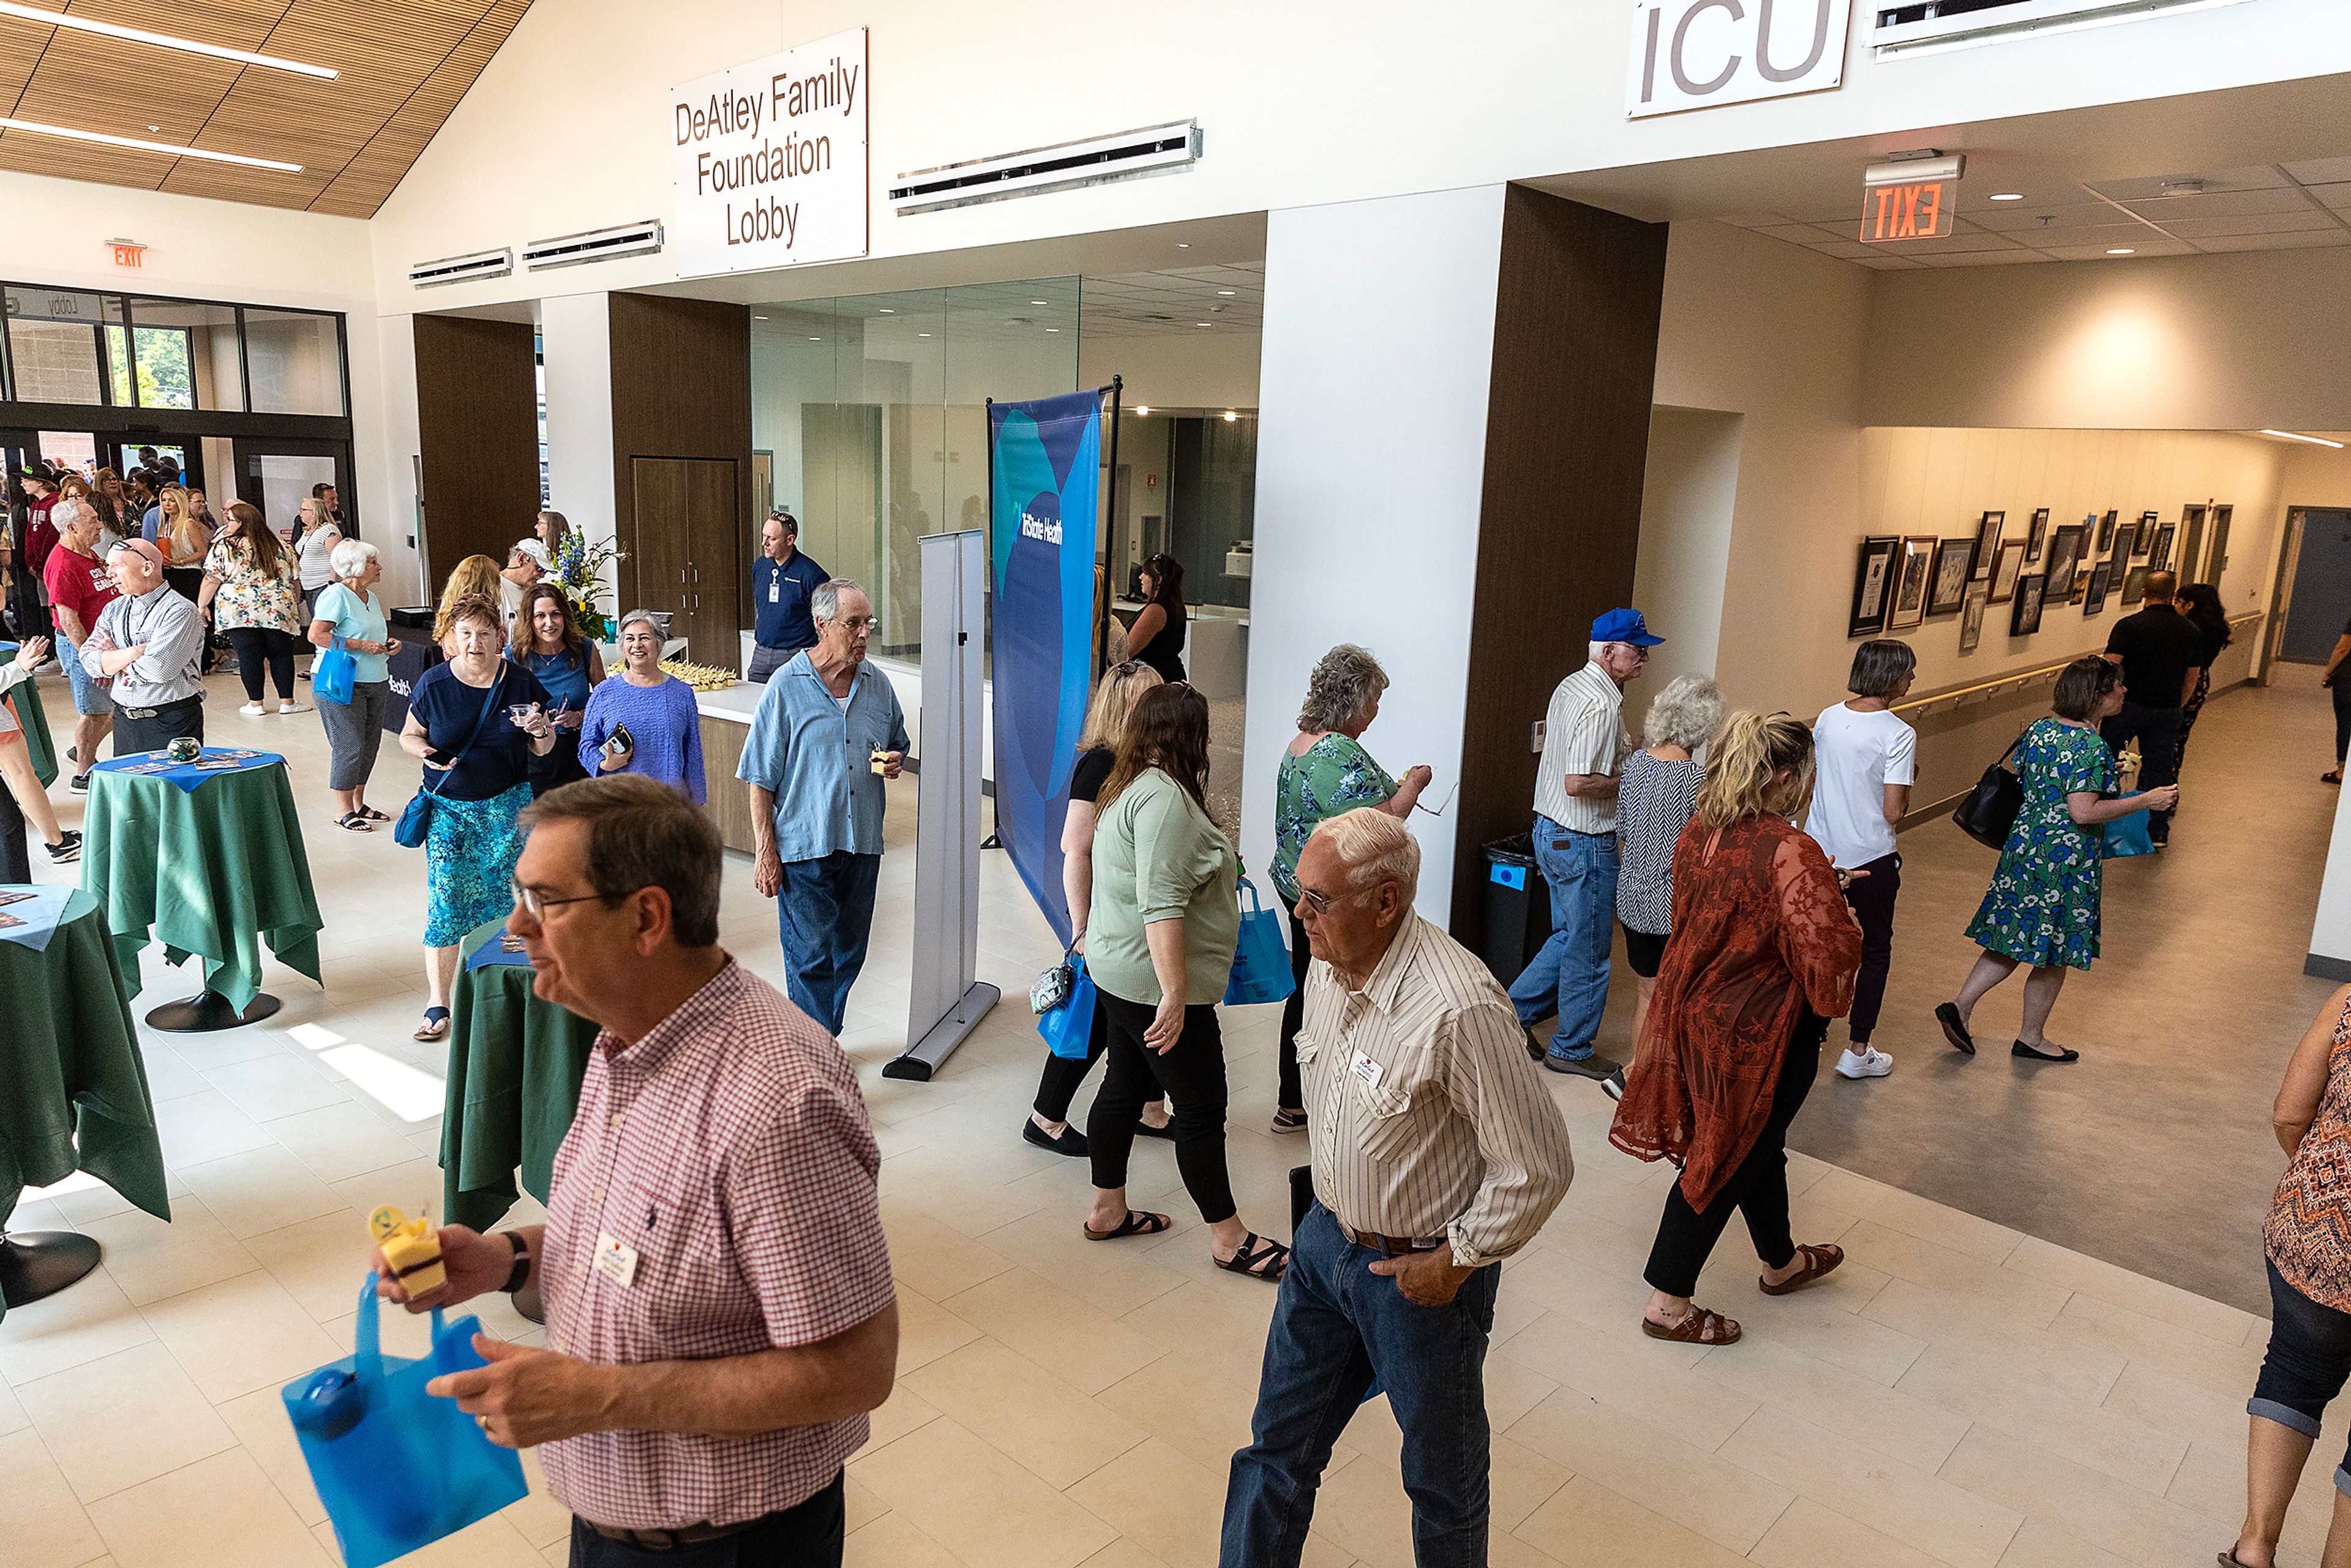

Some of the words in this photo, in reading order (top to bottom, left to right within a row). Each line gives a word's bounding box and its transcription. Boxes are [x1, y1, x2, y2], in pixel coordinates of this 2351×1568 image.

[1641, 0, 1831, 103] ICU
[676, 89, 763, 146] DeAtley
[772, 56, 858, 121] Family
[698, 130, 830, 195] Foundation
[727, 195, 798, 249] Lobby
[114, 246, 142, 268] EXIT
[1044, 517, 1063, 546] Health
